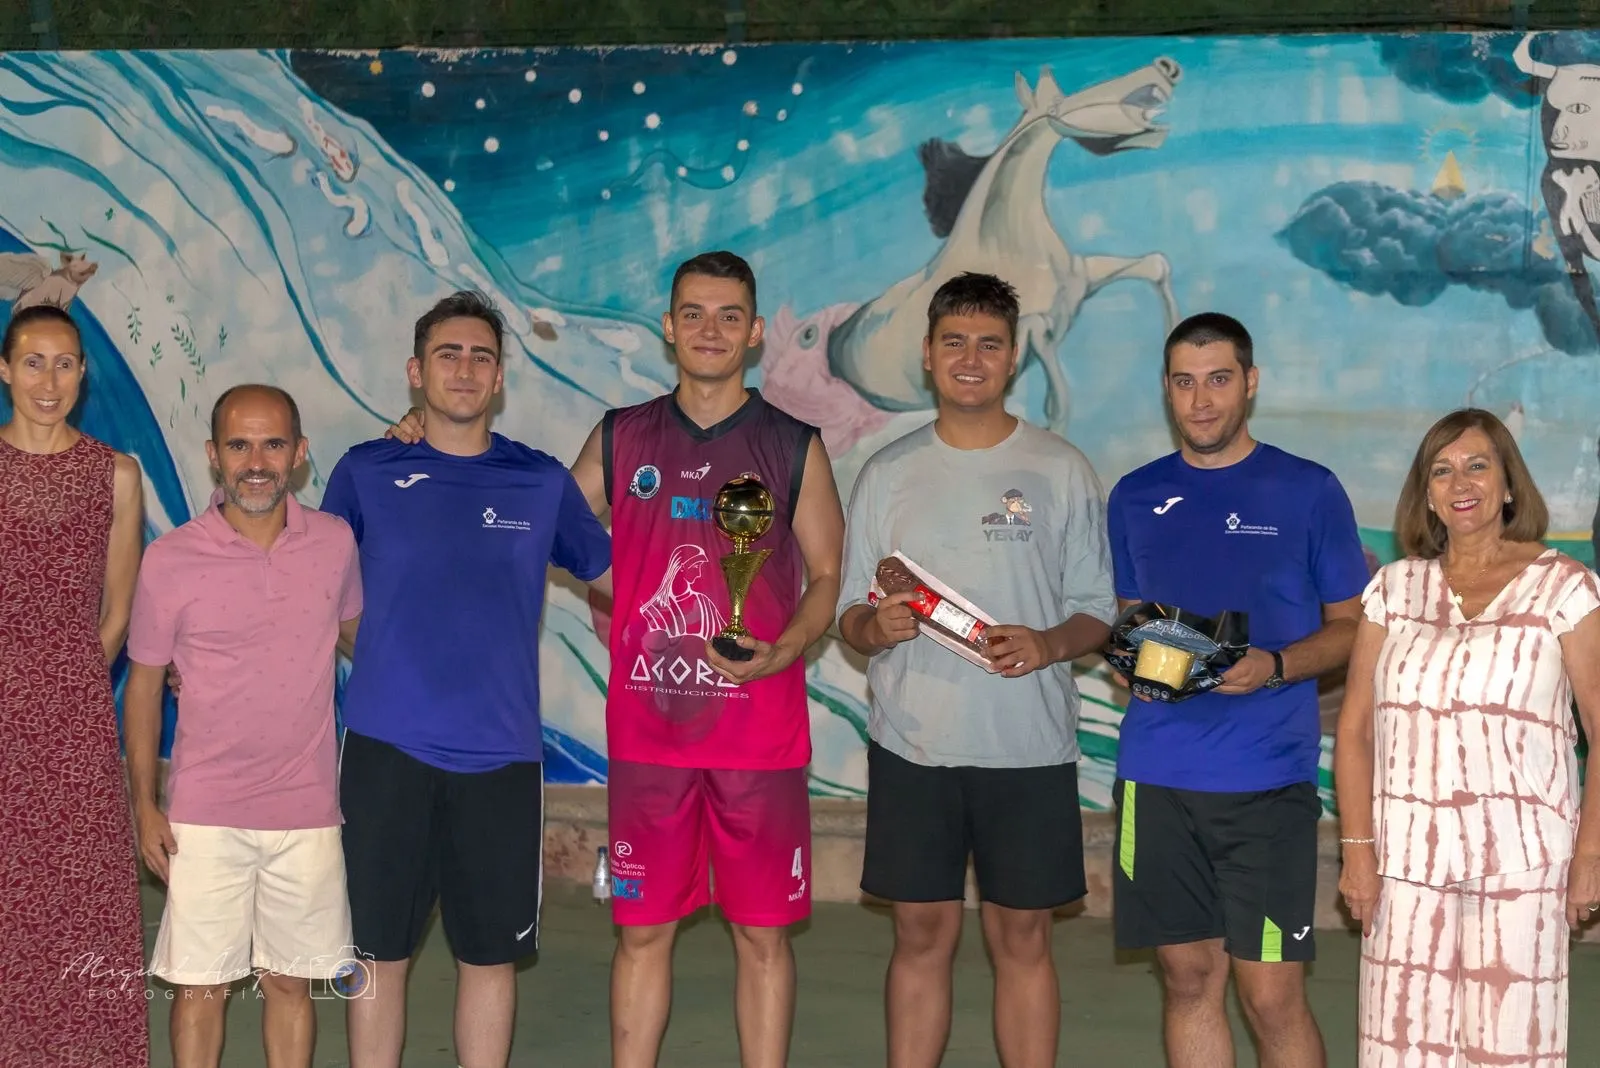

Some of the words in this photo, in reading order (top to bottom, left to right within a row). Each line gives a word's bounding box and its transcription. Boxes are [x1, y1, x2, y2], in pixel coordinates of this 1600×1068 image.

[680, 470, 700, 480] MKA
[983, 529, 1034, 542] YERAY
[624, 684, 750, 699] DISTRIBUCIONES
[791, 846, 803, 880] 4
